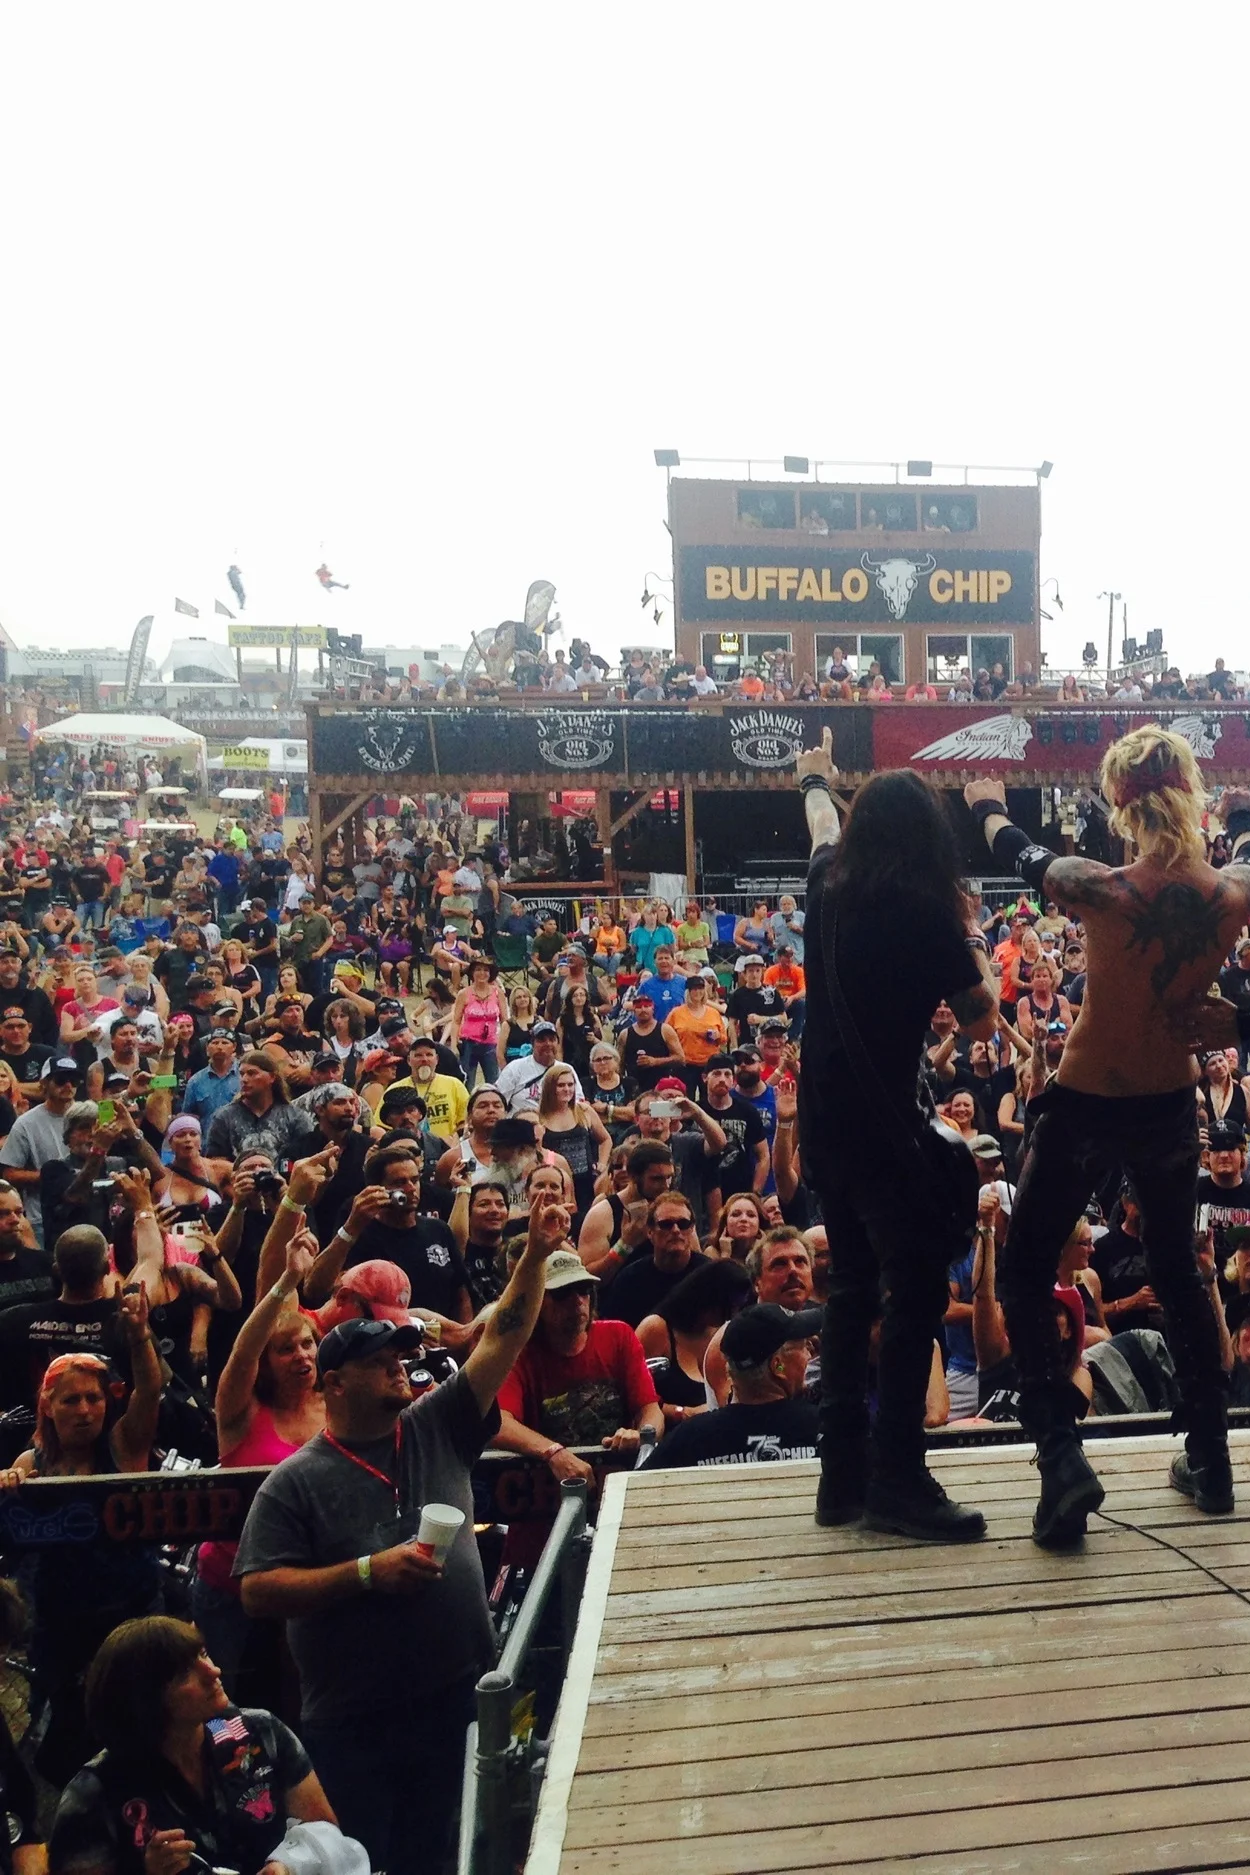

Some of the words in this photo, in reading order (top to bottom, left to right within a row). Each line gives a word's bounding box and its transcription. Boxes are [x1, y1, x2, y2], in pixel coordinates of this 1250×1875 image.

[706, 566, 869, 602] BUFFALO
[929, 569, 1012, 603] CHIP
[729, 716, 760, 737] JACK
[758, 709, 806, 737] DANIEL'S
[750, 727, 765, 735] OLD
[767, 727, 784, 735] TIME
[955, 729, 1001, 742] Indian
[565, 740, 587, 749] Old
[757, 739, 778, 749] Old
[223, 746, 270, 758] BOOTS
[426, 1102, 449, 1119] AFF
[747, 1435, 782, 1462] 75
[782, 1446, 817, 1461] CHIP
[102, 1487, 243, 1541] CHIP
